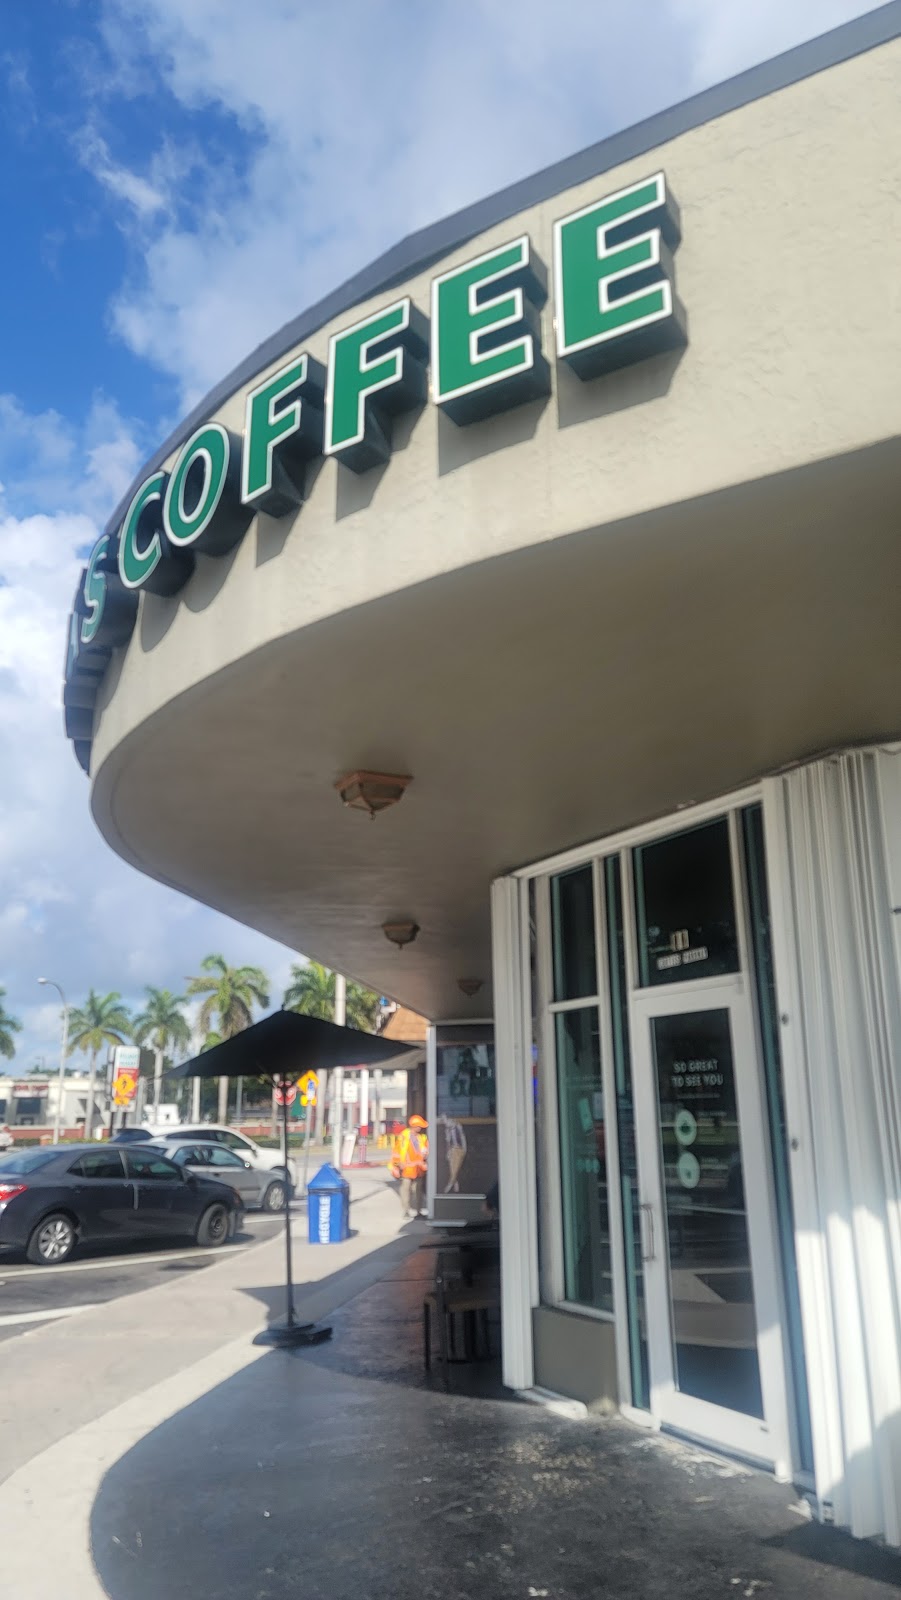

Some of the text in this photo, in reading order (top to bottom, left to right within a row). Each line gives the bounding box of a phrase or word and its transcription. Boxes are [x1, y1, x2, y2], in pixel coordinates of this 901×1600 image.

[118, 169, 674, 590] COFFEE
[673, 1058, 718, 1073] SO GREAT
[671, 1073, 724, 1088] TO SEE YOU
